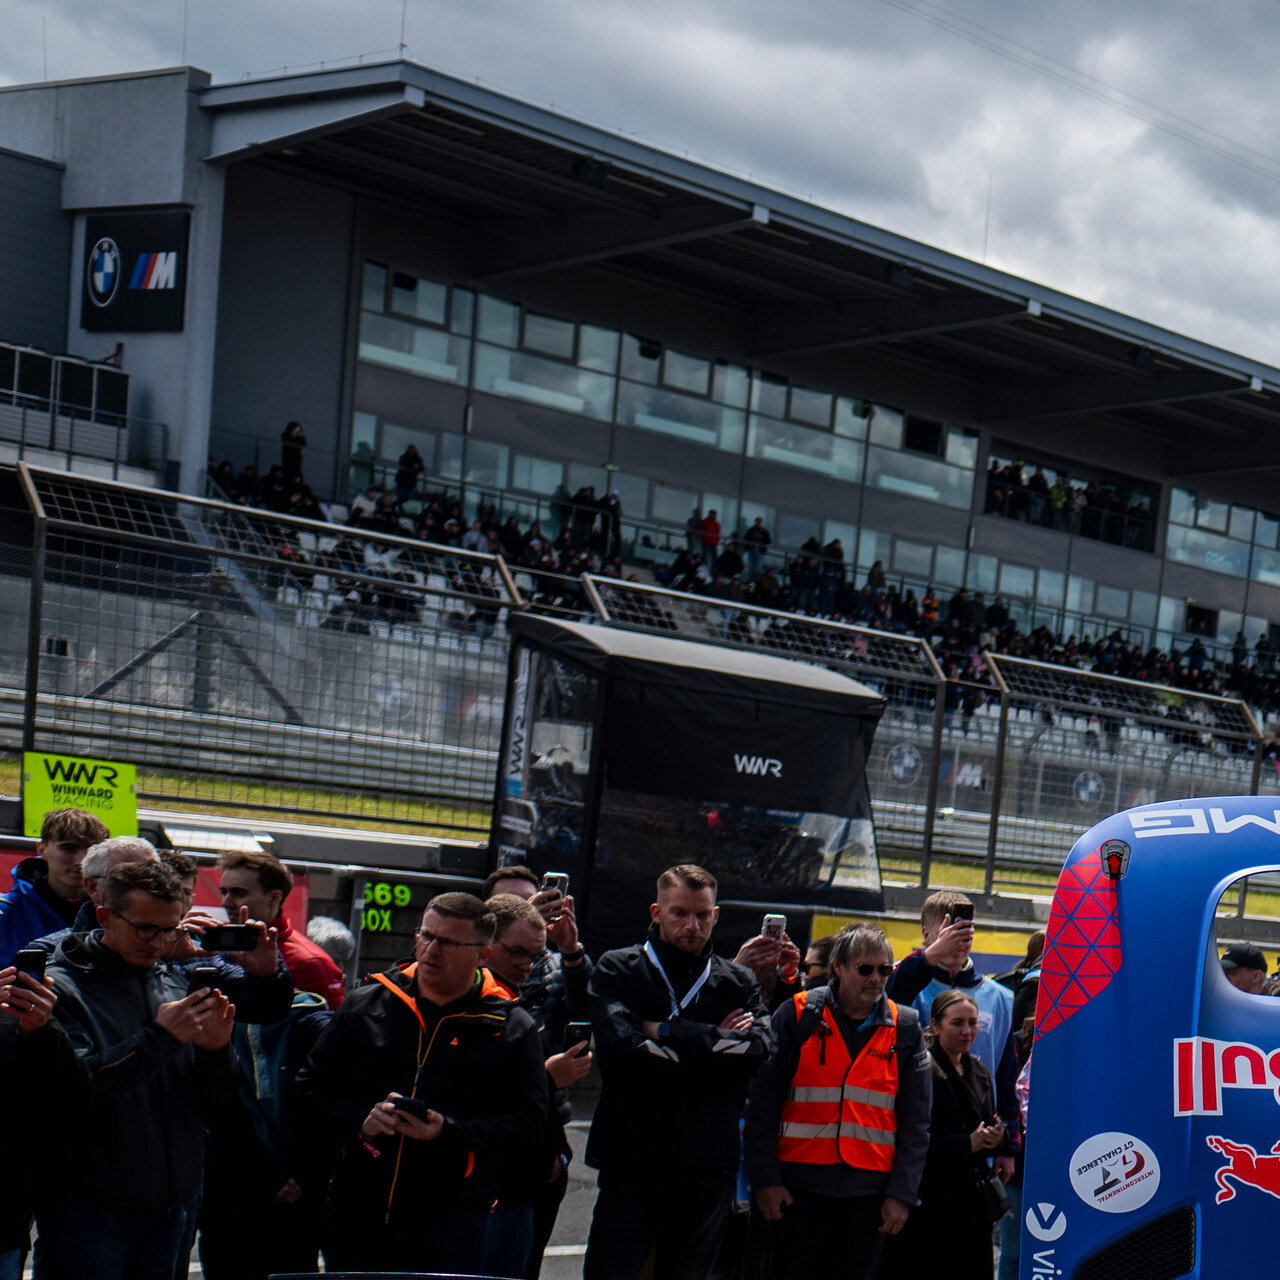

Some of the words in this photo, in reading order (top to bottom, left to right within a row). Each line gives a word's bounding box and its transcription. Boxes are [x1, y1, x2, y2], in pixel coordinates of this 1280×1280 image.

[52, 784, 113, 799] WINWARD
[53, 795, 113, 811] RACING
[361, 908, 393, 932] OX
[1123, 1140, 1135, 1150] GT
[1076, 1146, 1123, 1176] CHALLENGE
[1097, 1169, 1155, 1203] INTERCONTINENTAL
